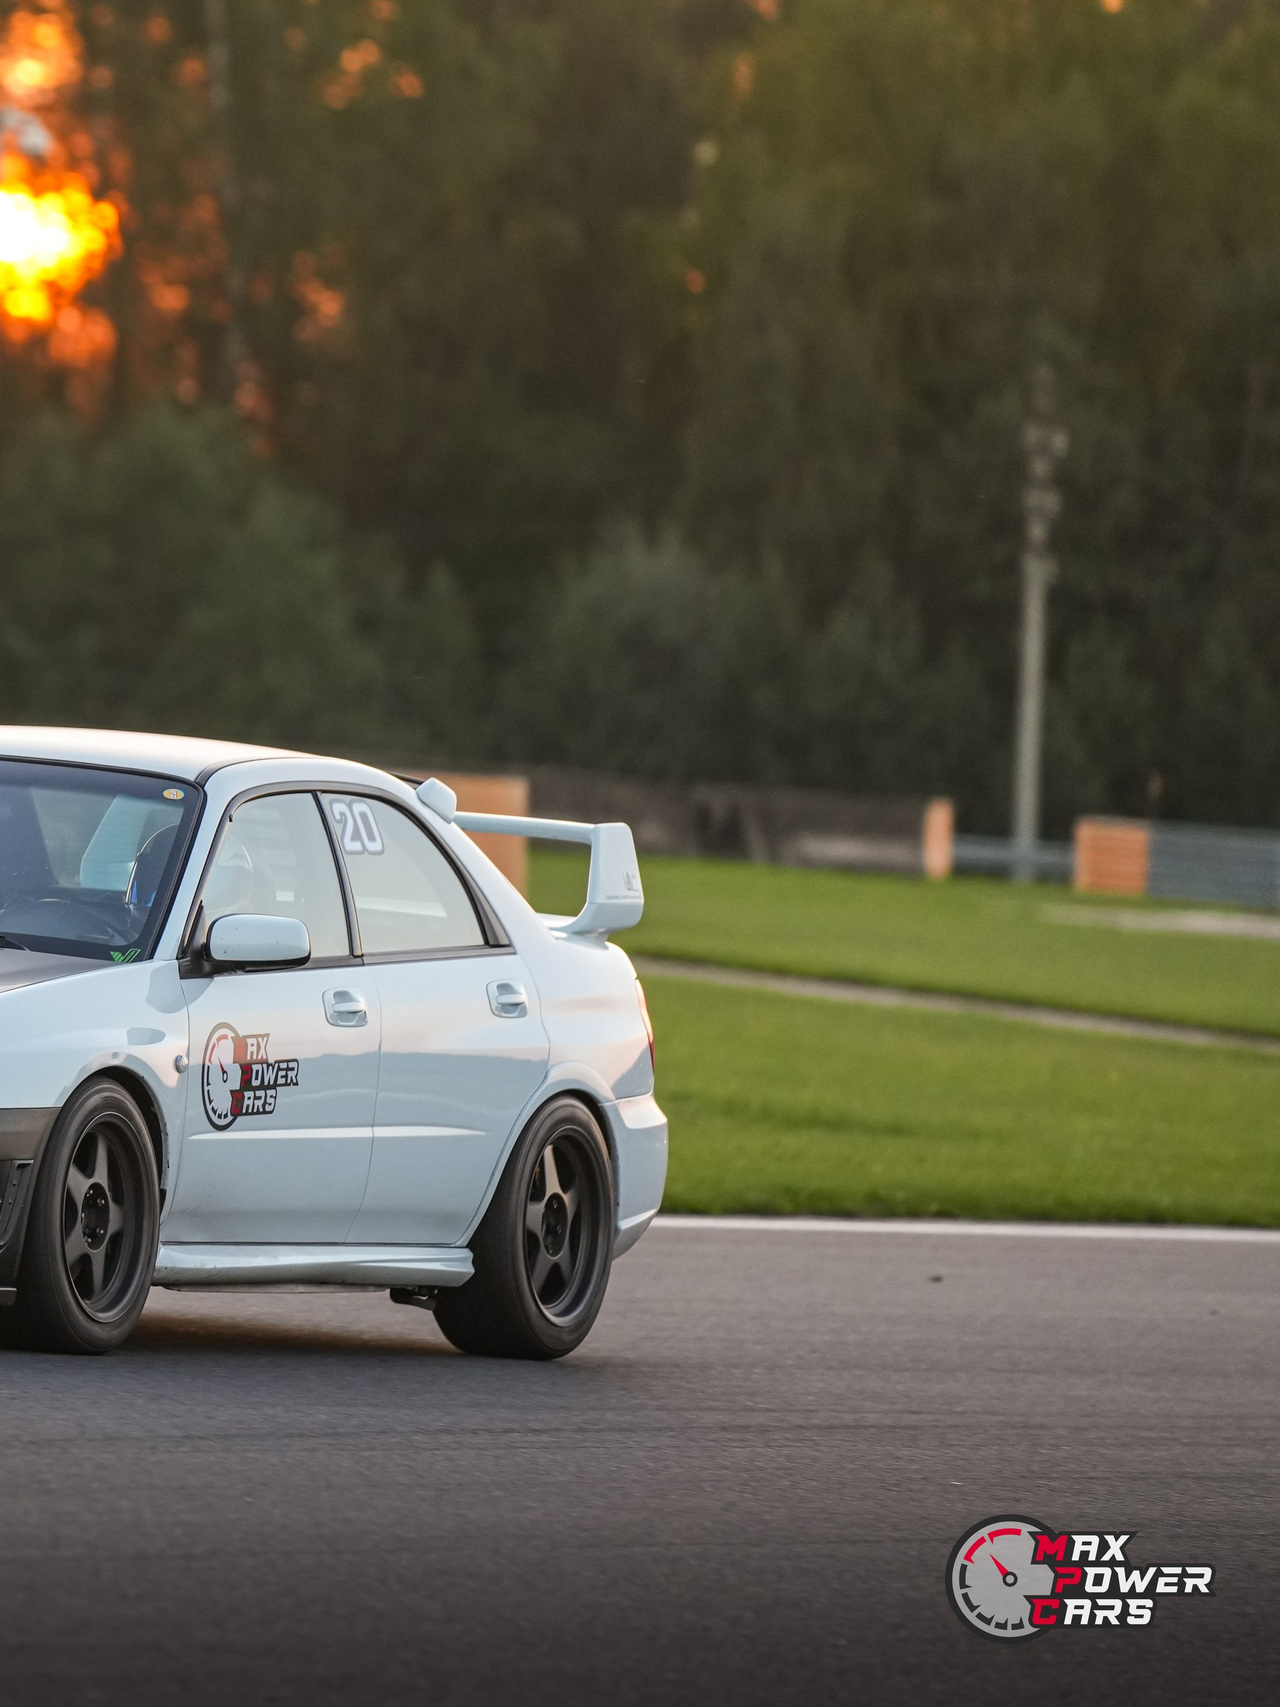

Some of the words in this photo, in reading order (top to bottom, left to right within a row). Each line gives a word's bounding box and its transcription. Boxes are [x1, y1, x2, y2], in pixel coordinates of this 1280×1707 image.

[330, 800, 384, 854] 20
[234, 1036, 268, 1060] MAX
[241, 1062, 298, 1086] POWER
[232, 1090, 276, 1114] CARS
